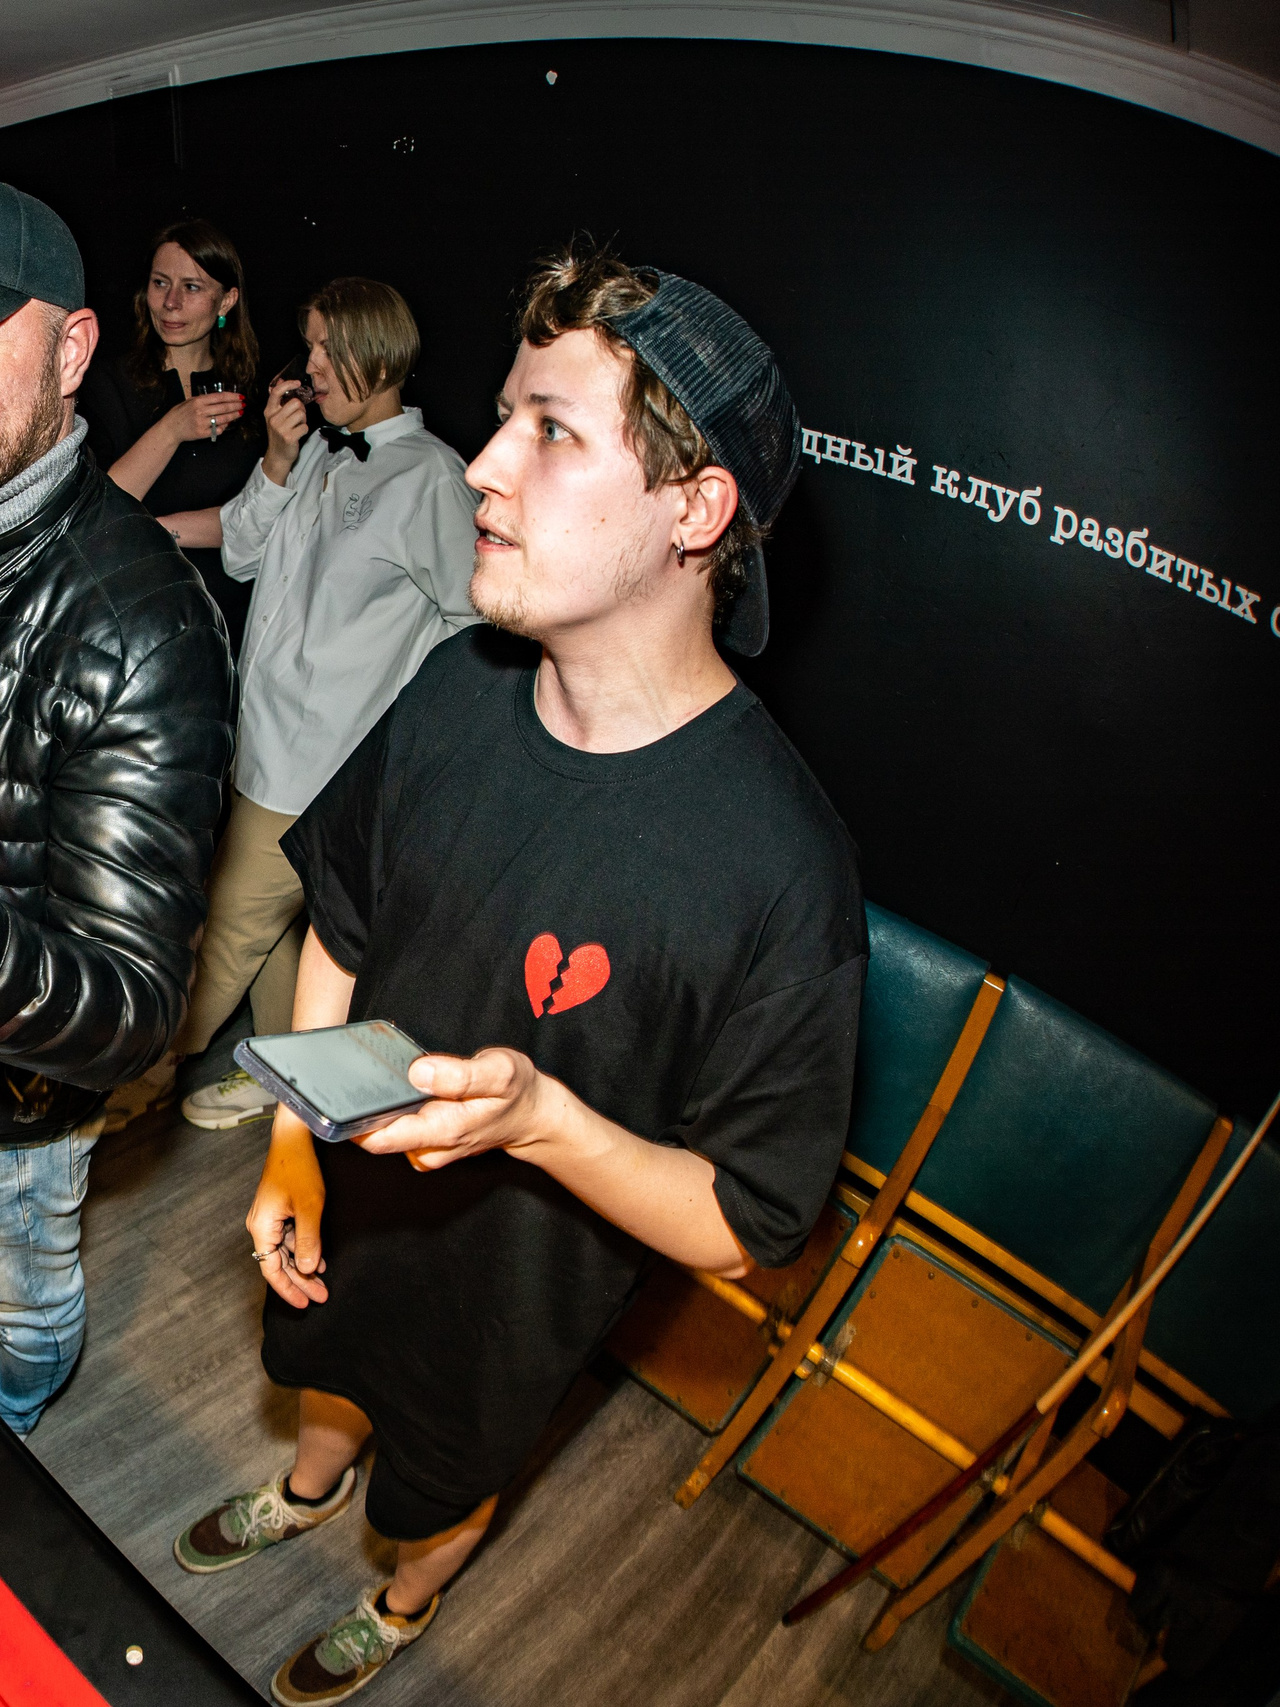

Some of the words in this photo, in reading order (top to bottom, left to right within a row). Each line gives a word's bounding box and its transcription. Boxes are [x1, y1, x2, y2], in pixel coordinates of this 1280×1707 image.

[801, 427, 917, 485] дный
[930, 464, 1042, 526] клуб
[1050, 505, 1261, 625] разбитых
